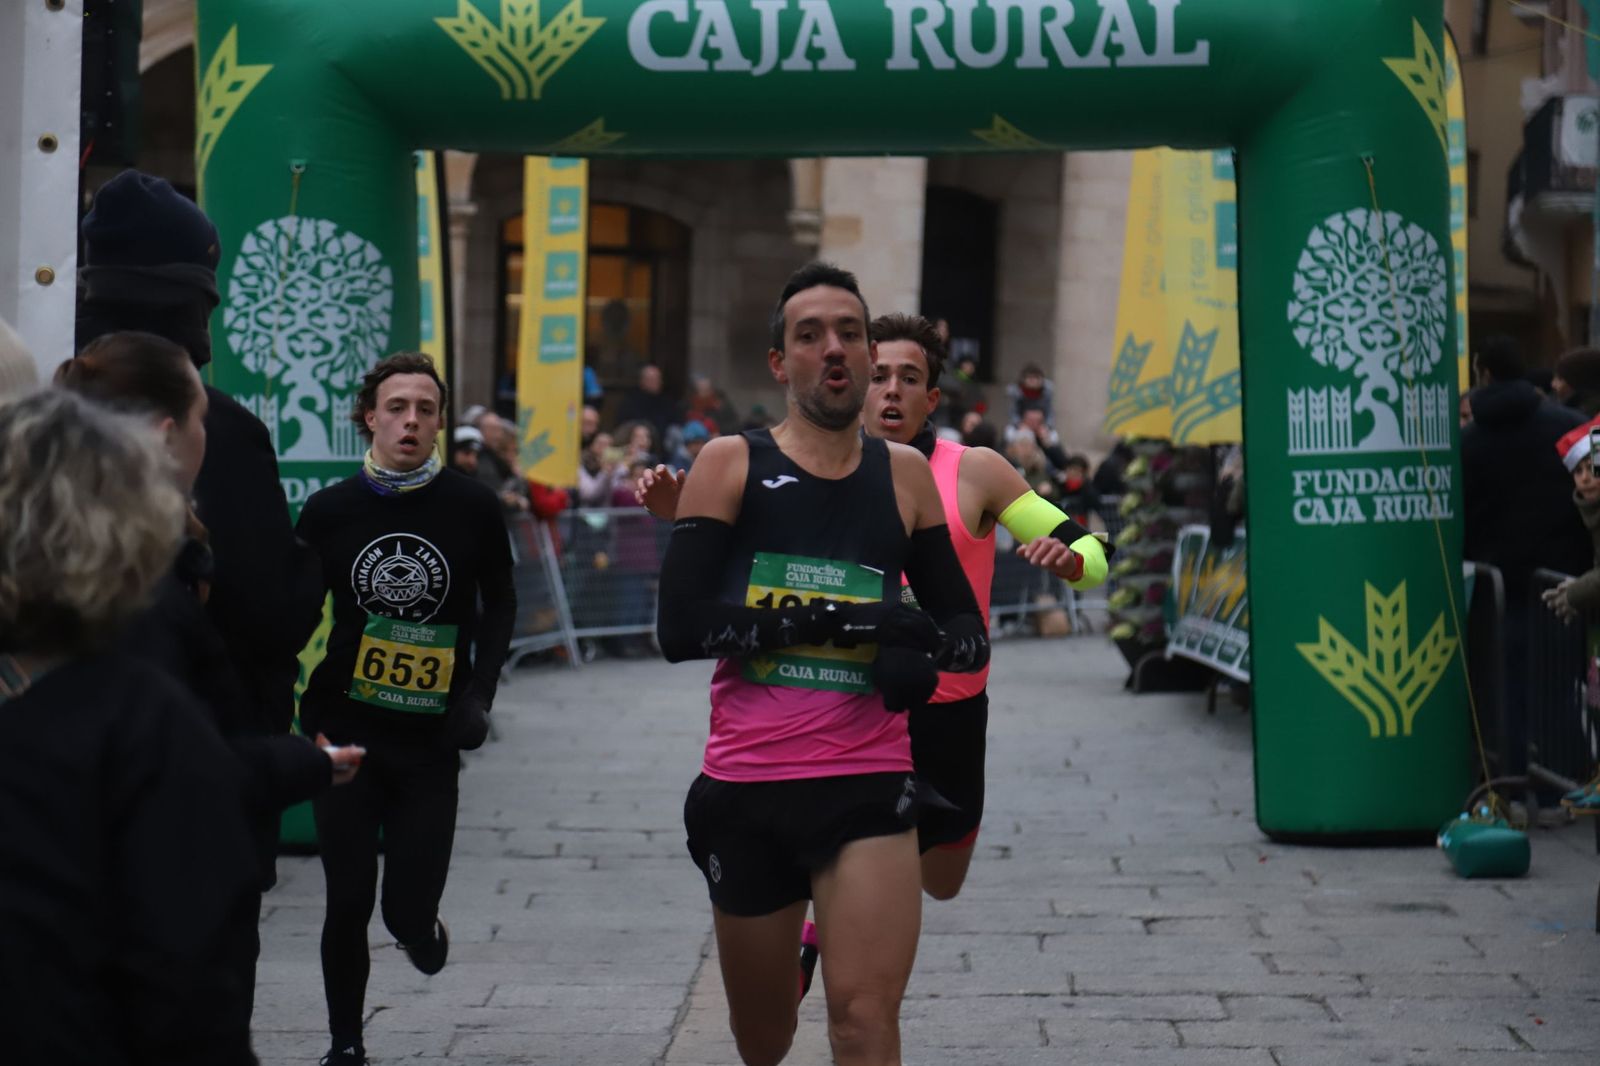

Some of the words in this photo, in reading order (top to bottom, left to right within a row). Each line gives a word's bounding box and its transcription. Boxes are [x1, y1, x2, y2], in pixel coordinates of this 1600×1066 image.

[627, 0, 856, 76] CAJA
[886, 0, 1209, 69] RURAL
[1292, 465, 1452, 496] FUNDACION
[1293, 496, 1367, 525] CAJA
[1373, 493, 1454, 522] RURAL
[358, 547, 383, 592] NATACIÓN
[415, 546, 443, 588] ZAMORA
[785, 572, 810, 582] CAJA
[812, 574, 846, 587] RURAL
[787, 563, 846, 578] FUNDACON
[392, 624, 437, 636] FUNDACON
[363, 647, 440, 689] 653
[778, 664, 815, 679] CAJA
[818, 668, 866, 684] RURAL
[378, 691, 405, 704] CAJA
[406, 696, 441, 707] RURAL
